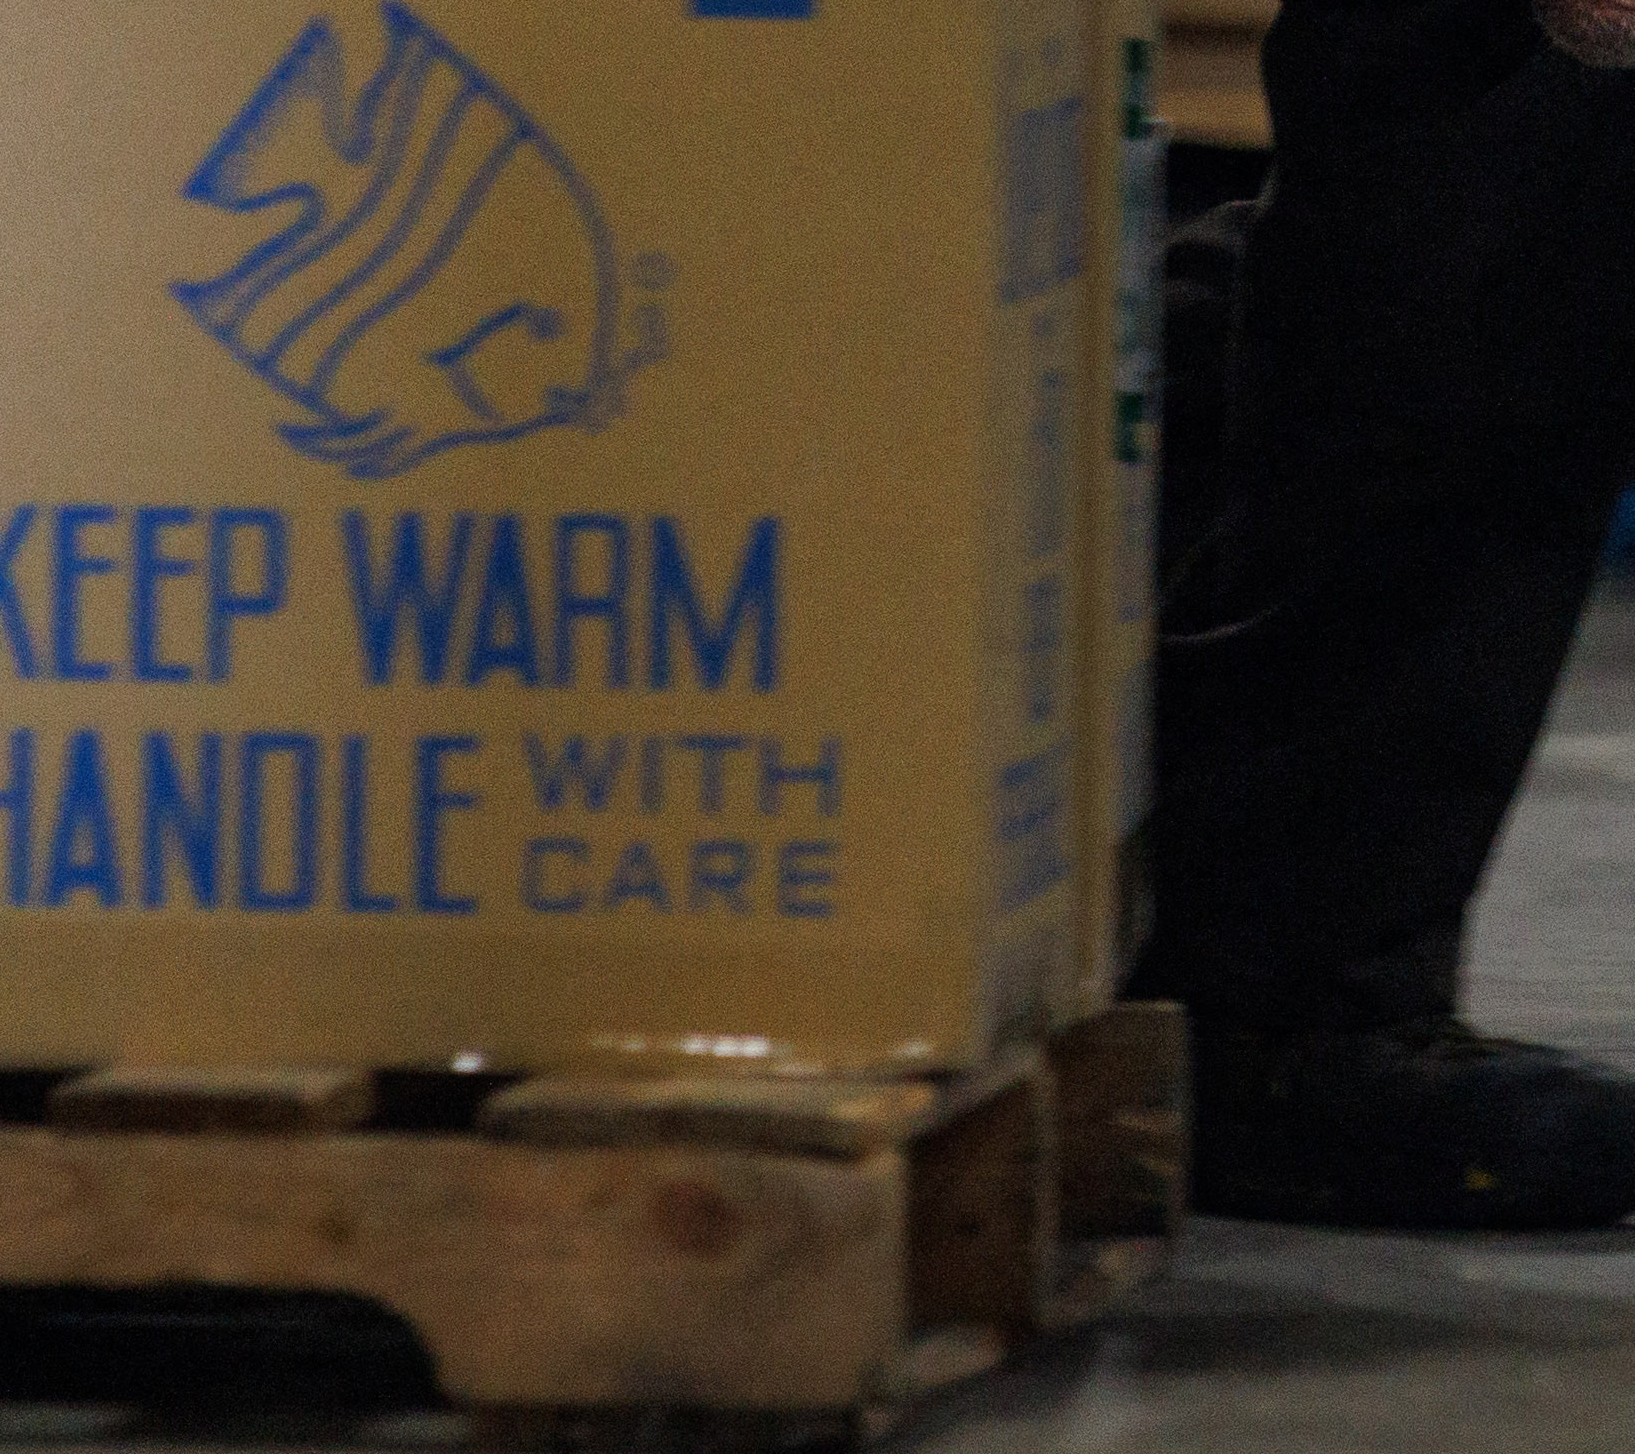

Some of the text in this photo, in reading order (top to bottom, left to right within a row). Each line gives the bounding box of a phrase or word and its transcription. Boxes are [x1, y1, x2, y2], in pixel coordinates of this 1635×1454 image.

[341, 509, 786, 694] WARM
[522, 731, 845, 816] WITH
[522, 837, 838, 919] CARE
